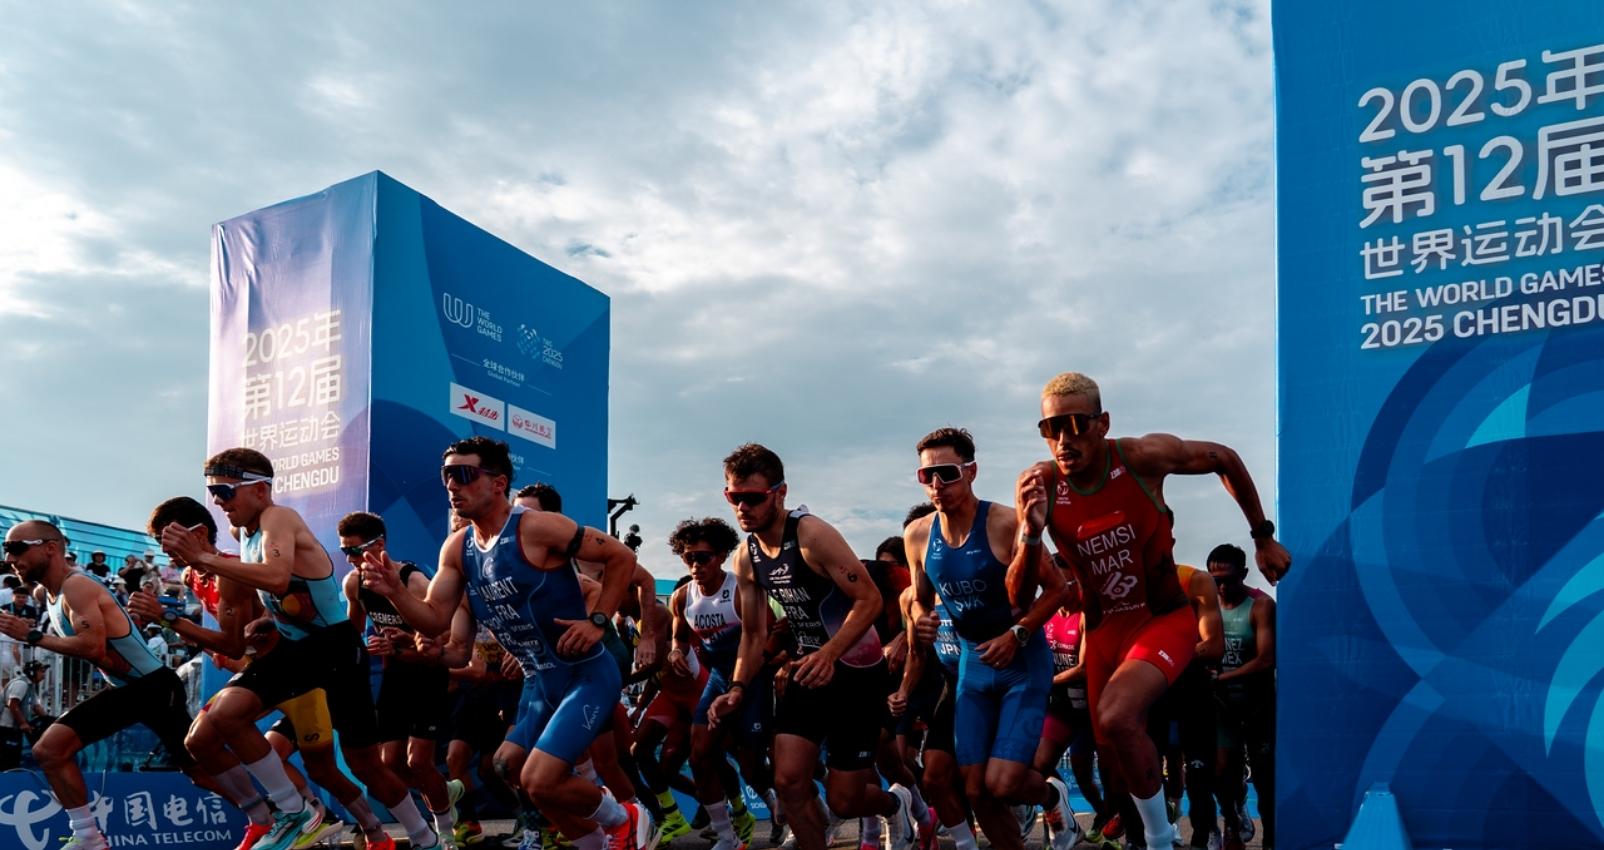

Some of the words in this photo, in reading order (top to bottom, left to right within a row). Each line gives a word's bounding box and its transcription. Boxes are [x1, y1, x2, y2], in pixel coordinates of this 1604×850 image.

[1358, 44, 1604, 143] 2025年
[1360, 115, 1604, 229] 第12届
[1360, 290, 1408, 315] THE
[1415, 276, 1513, 308] WORLD
[1520, 263, 1604, 294] GAME
[477, 307, 491, 320] THE
[477, 316, 503, 334] WORLD
[242, 310, 341, 368] 2025年
[477, 325, 503, 342] GAMES
[1360, 314, 1444, 349] 2025
[243, 354, 342, 420] 第12届
[242, 410, 341, 450] 世界运动会
[272, 454, 299, 474] ORLD
[301, 446, 340, 469] GAMES
[274, 465, 340, 495] CHENGDU
[1077, 523, 1136, 557] NEMSI
[1091, 549, 1134, 576] MAR
[938, 578, 987, 597] KUBO
[954, 597, 984, 613] SVK
[694, 613, 728, 630] ACOSTA
[1225, 638, 1243, 652] NEZ
[89, 790, 228, 831] 中国电信
[106, 833, 148, 848] HINA
[152, 829, 233, 844] TELECOM
